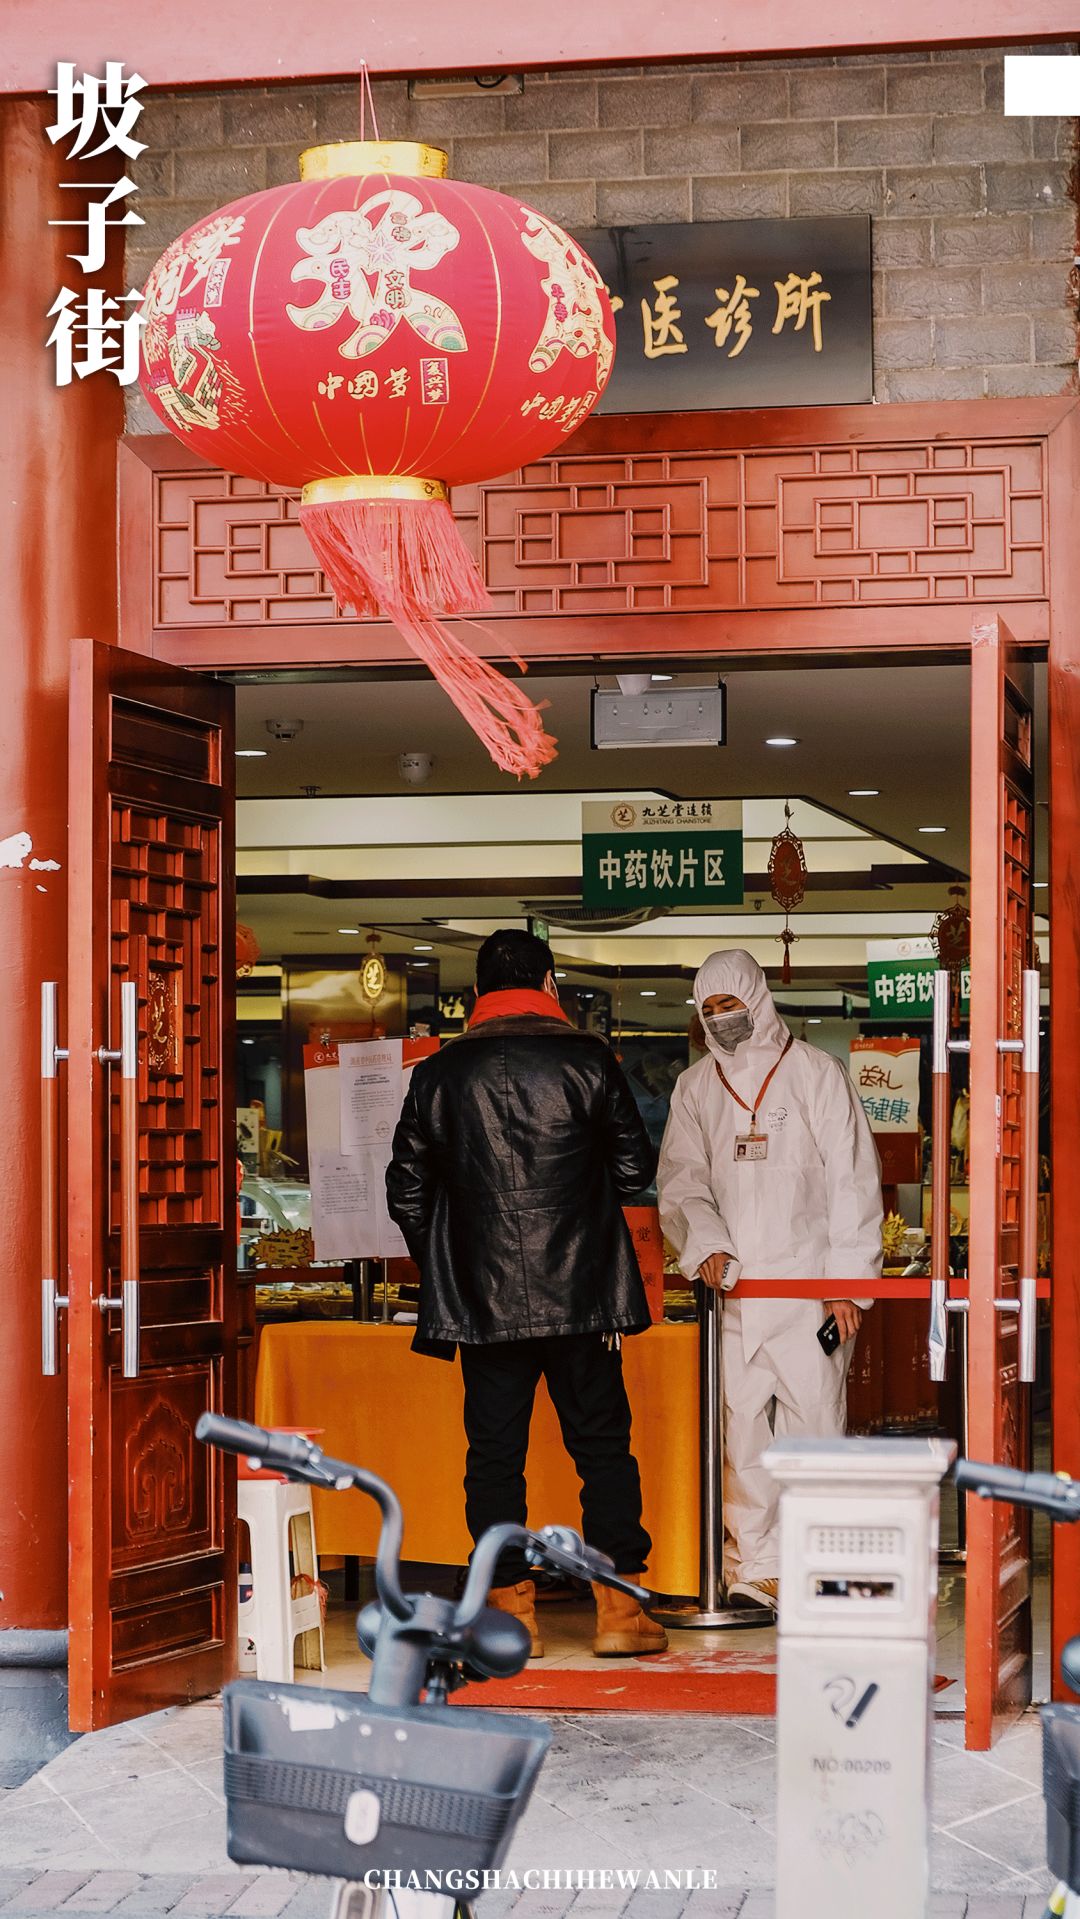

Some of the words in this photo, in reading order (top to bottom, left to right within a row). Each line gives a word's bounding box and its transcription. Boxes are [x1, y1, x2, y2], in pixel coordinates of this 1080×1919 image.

[329, 258, 352, 300] 民主
[384, 269, 406, 310] 文明
[606, 271, 832, 360] 医诊所
[599, 848, 726, 890] 中药饮片区
[874, 970, 971, 1006] 中药饮区
[858, 1064, 903, 1090] 送礼
